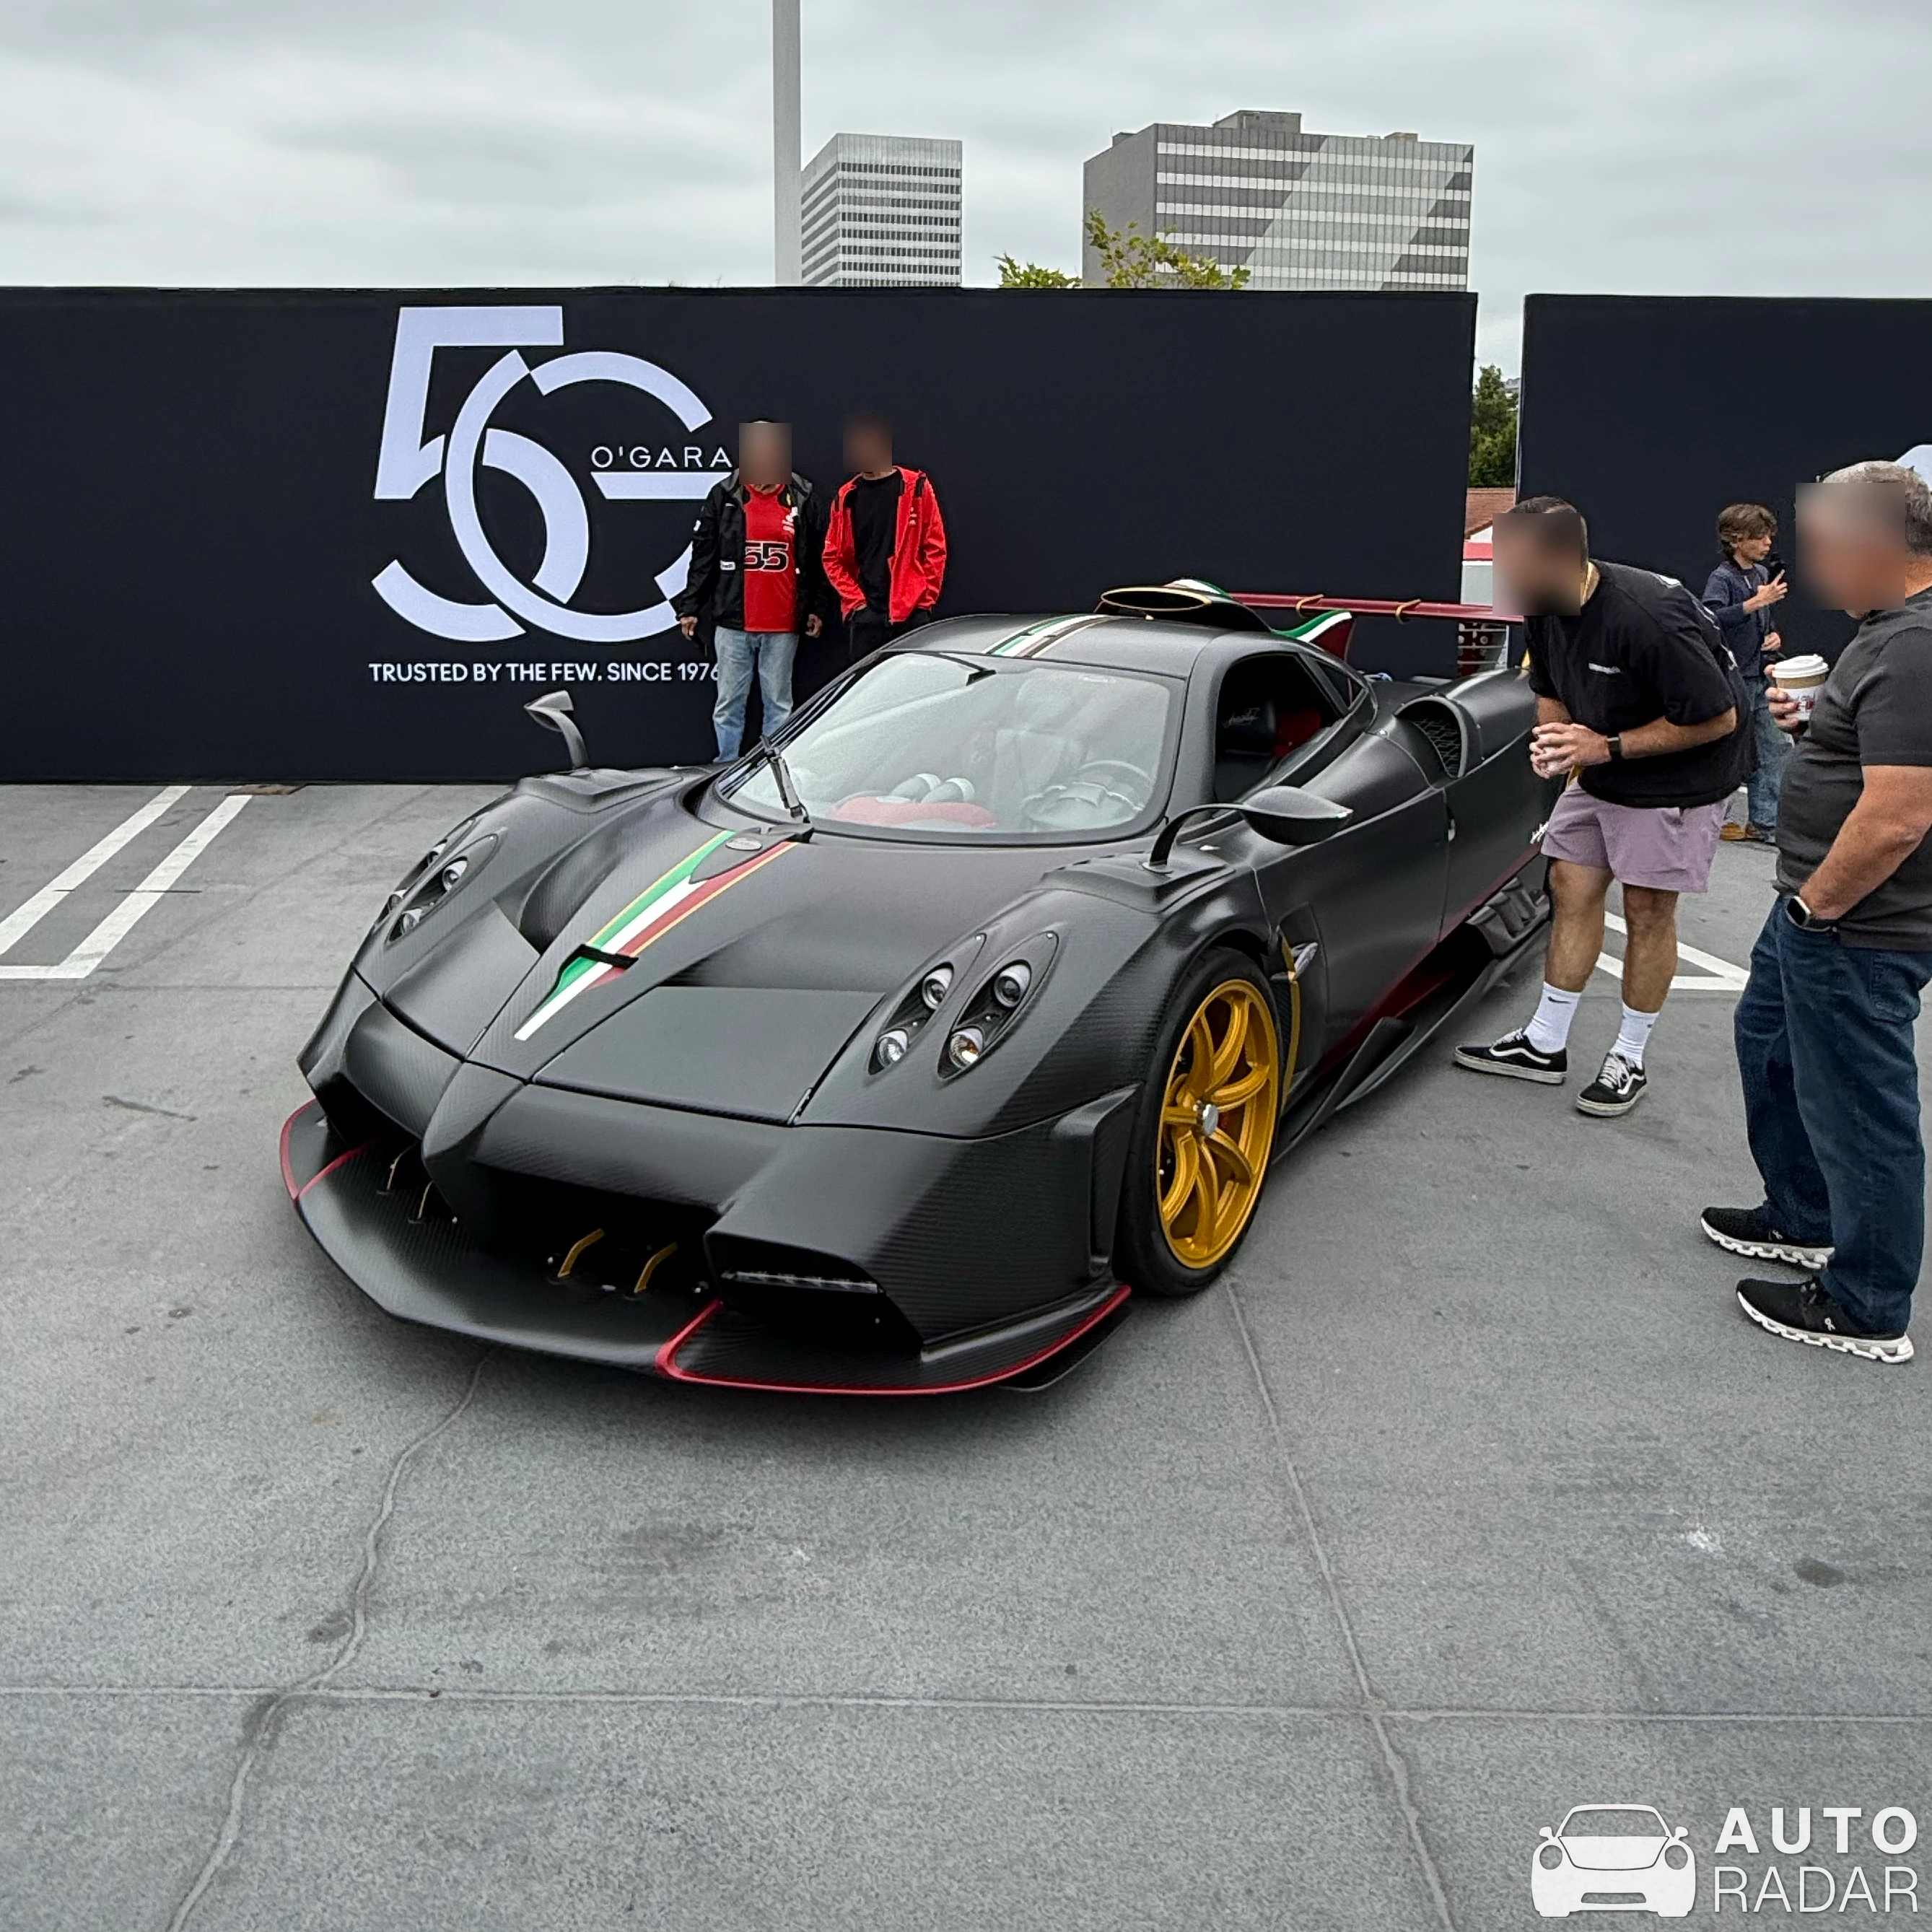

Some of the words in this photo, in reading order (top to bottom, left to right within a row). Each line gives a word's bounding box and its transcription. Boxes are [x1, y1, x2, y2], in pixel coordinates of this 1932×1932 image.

[591, 446, 733, 468] O'GARA
[744, 541, 789, 572] 55
[369, 663, 468, 682] TRUSTED
[473, 663, 502, 682] BY
[506, 663, 547, 682] THE
[551, 663, 603, 682] FEW.
[608, 663, 673, 682] SINCE
